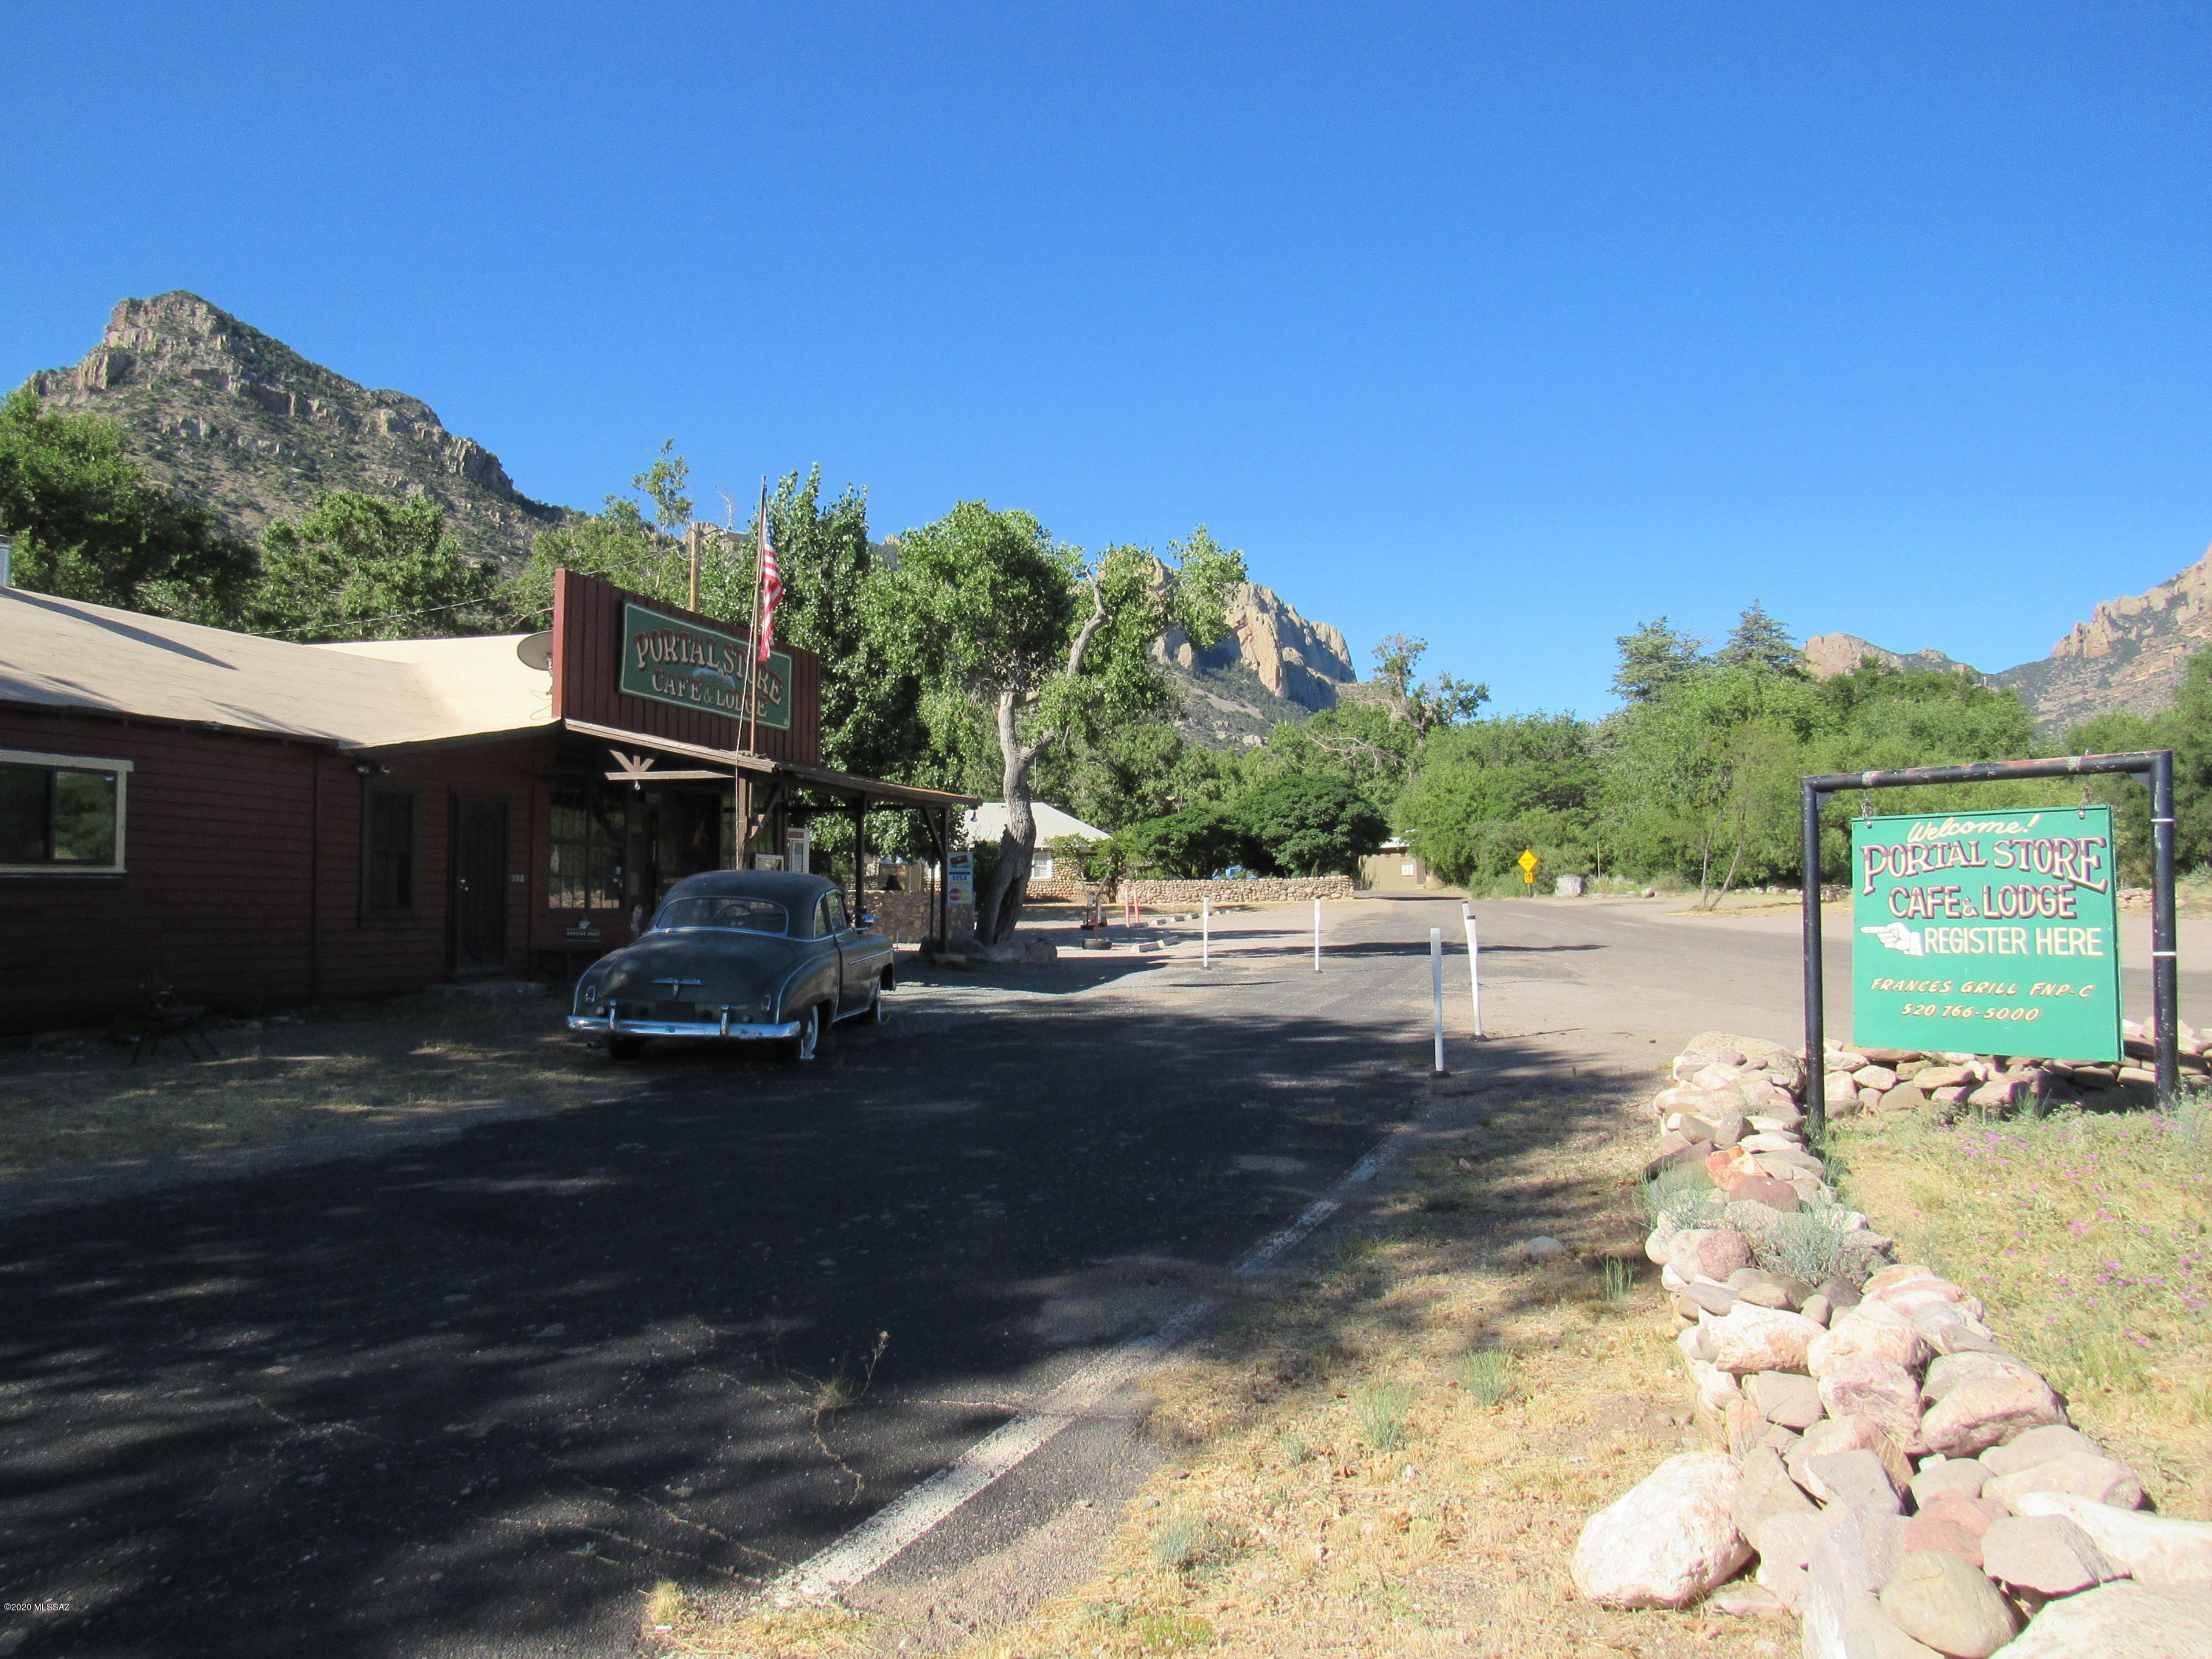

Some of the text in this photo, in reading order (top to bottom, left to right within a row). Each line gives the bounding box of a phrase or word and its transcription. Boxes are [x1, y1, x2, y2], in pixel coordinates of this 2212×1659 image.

[633, 627, 720, 669] PORTAL
[652, 669, 767, 717] CAFE & LODGE
[1907, 813, 2042, 844] Welcome!
[1860, 836, 2109, 896] PORTAL STORE
[1888, 883, 2078, 919] CAFE & LODGE
[1924, 927, 2105, 956] REGISTER HERE
[1871, 978, 2096, 999] FRANCES GRILL FNP-C
[1901, 1004, 2041, 1022] 520 766-5000
